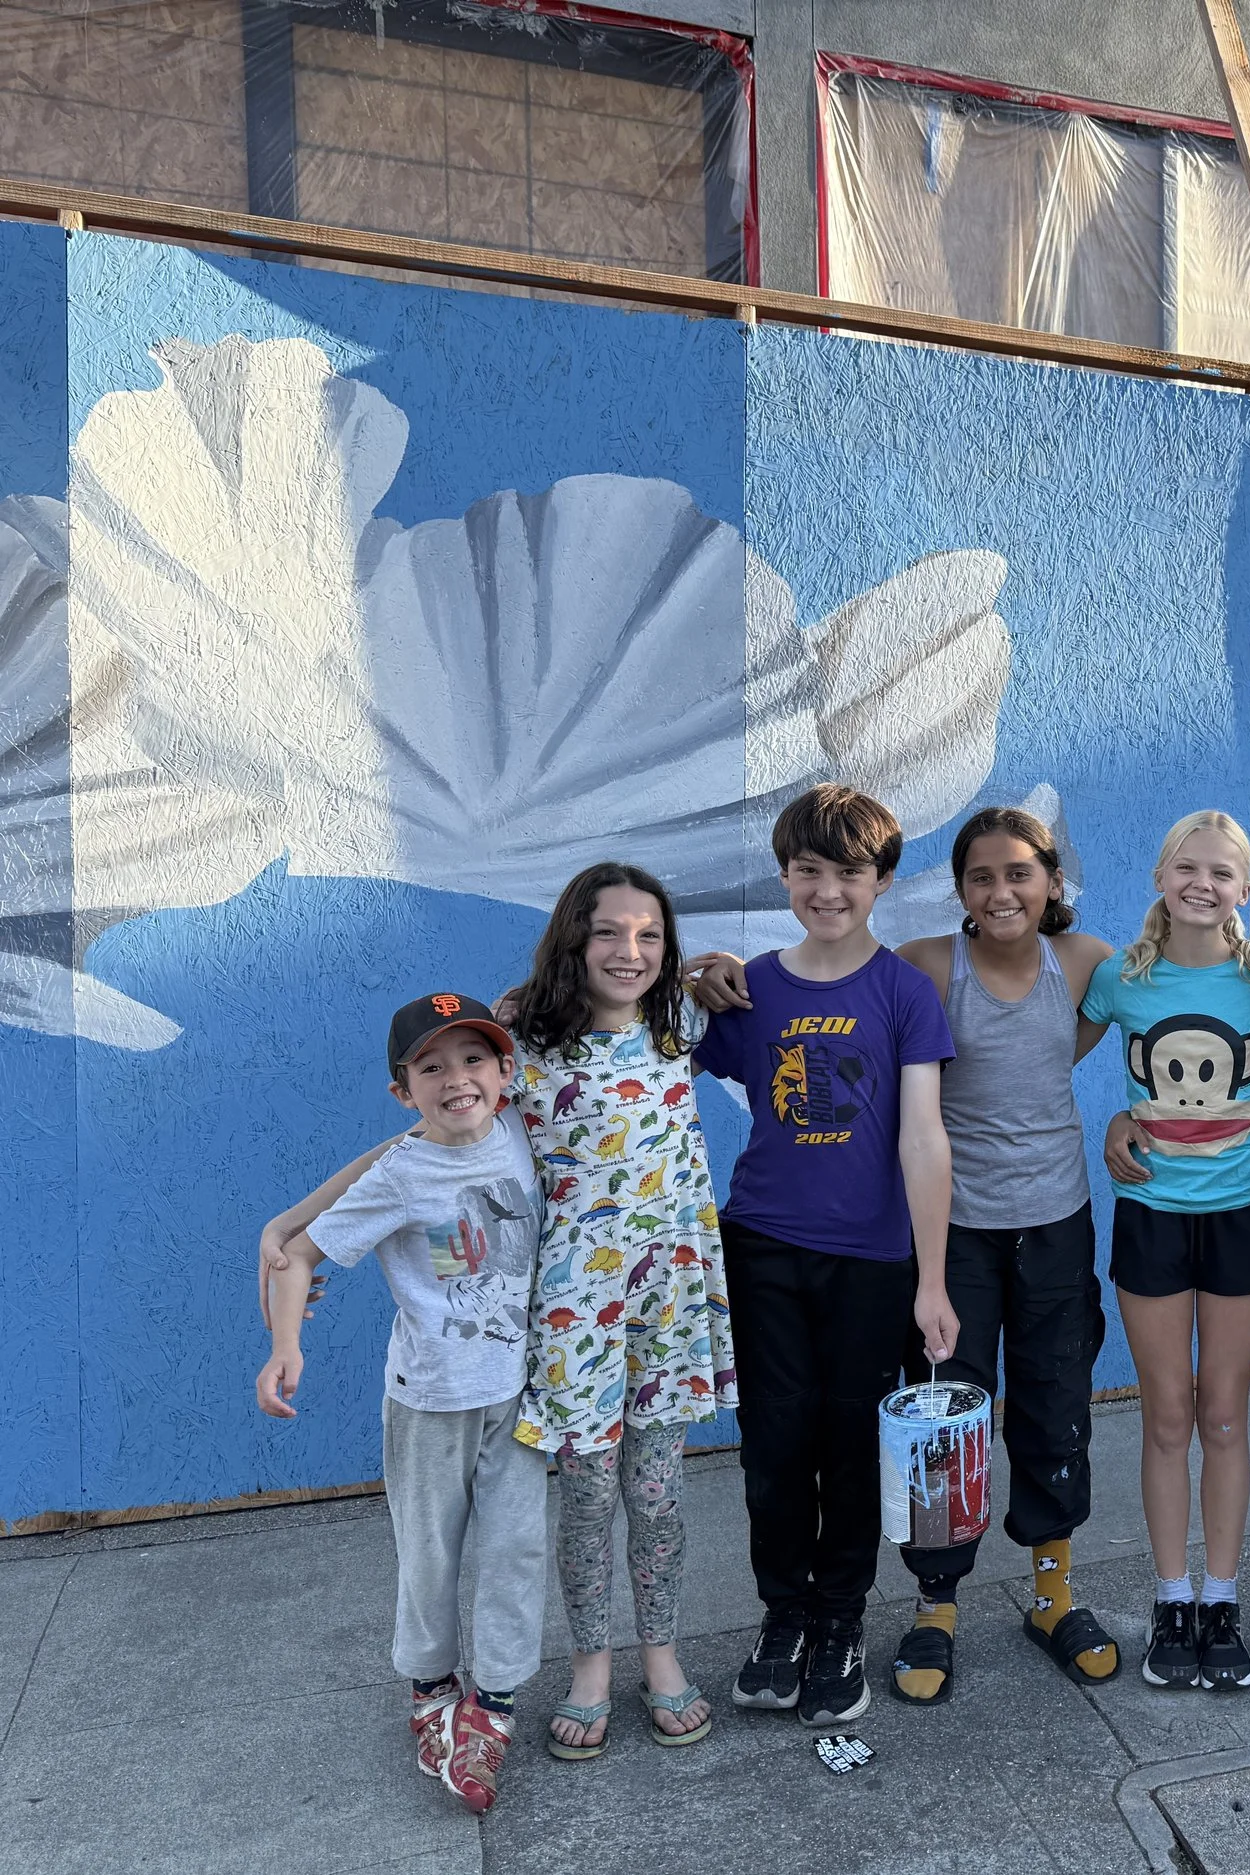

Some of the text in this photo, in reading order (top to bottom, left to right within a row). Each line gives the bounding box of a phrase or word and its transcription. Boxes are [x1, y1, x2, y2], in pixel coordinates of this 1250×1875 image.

[432, 995, 460, 1016] SF
[781, 1016, 858, 1038] JEDI
[806, 1045, 834, 1124] BOBCATS
[795, 1131, 852, 1144] 2022
[819, 1738, 841, 1760] EAST
